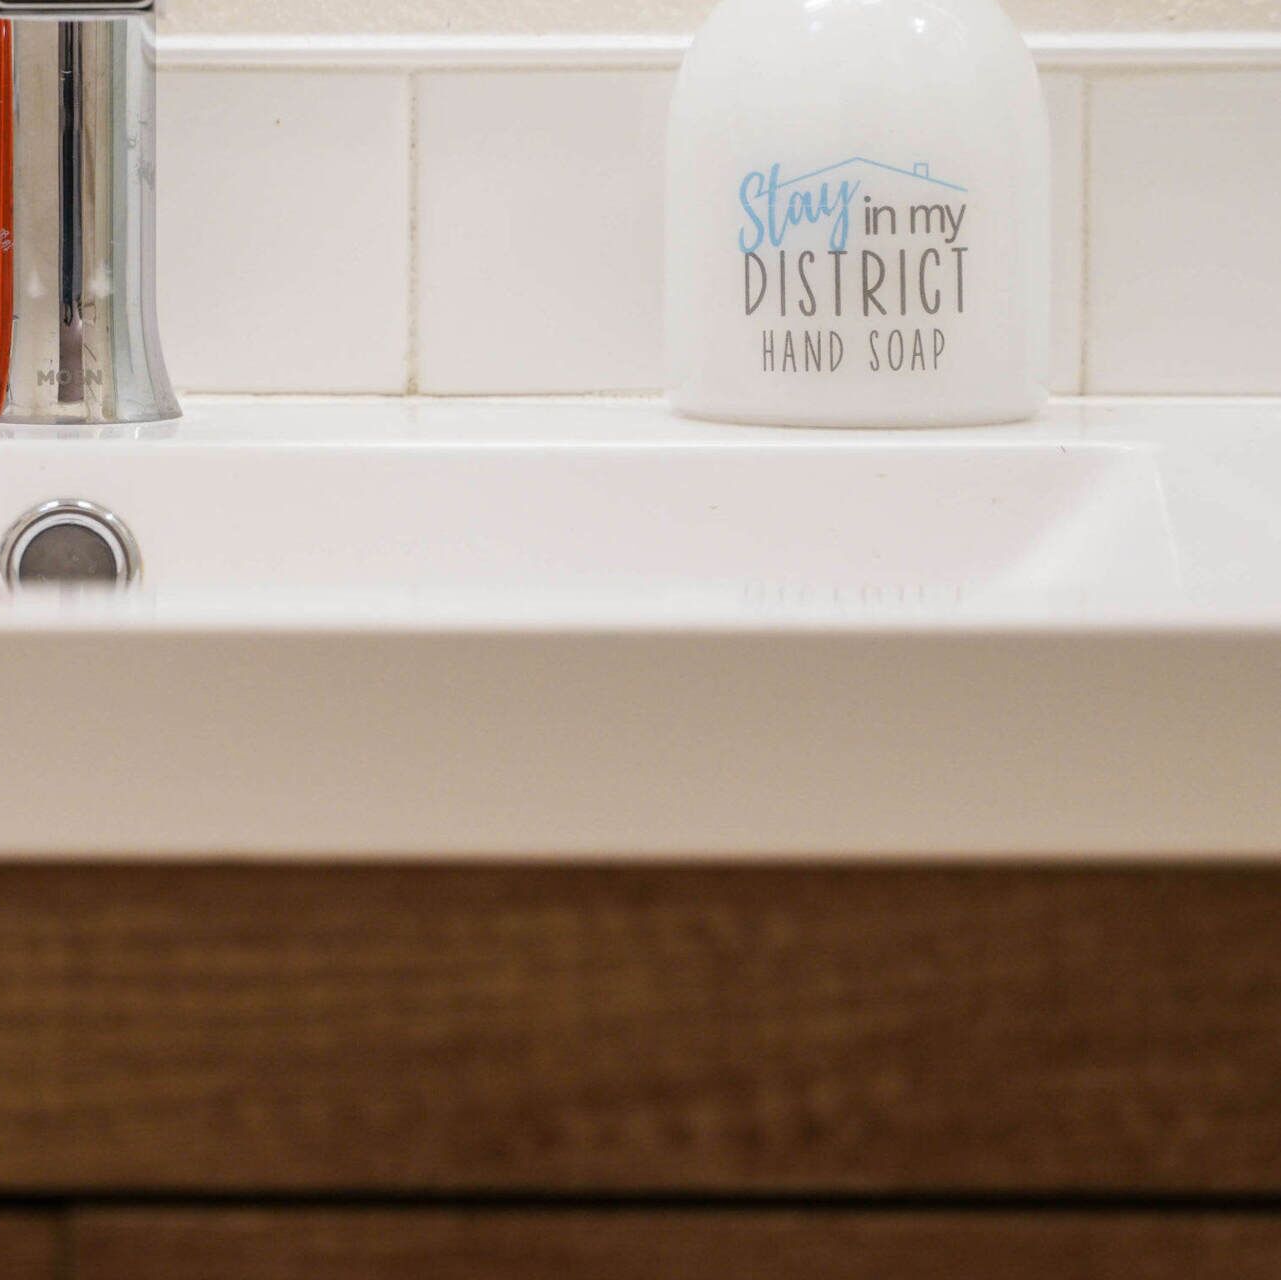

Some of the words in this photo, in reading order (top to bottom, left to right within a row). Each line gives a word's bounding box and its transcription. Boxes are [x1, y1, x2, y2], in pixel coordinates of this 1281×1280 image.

[738, 163, 861, 253] Stay
[864, 195, 897, 235] in
[910, 203, 967, 244] my
[743, 247, 969, 317] DISTRICT
[37, 369, 103, 386] MON
[762, 329, 844, 372] HAND
[870, 328, 946, 371] SOAP
